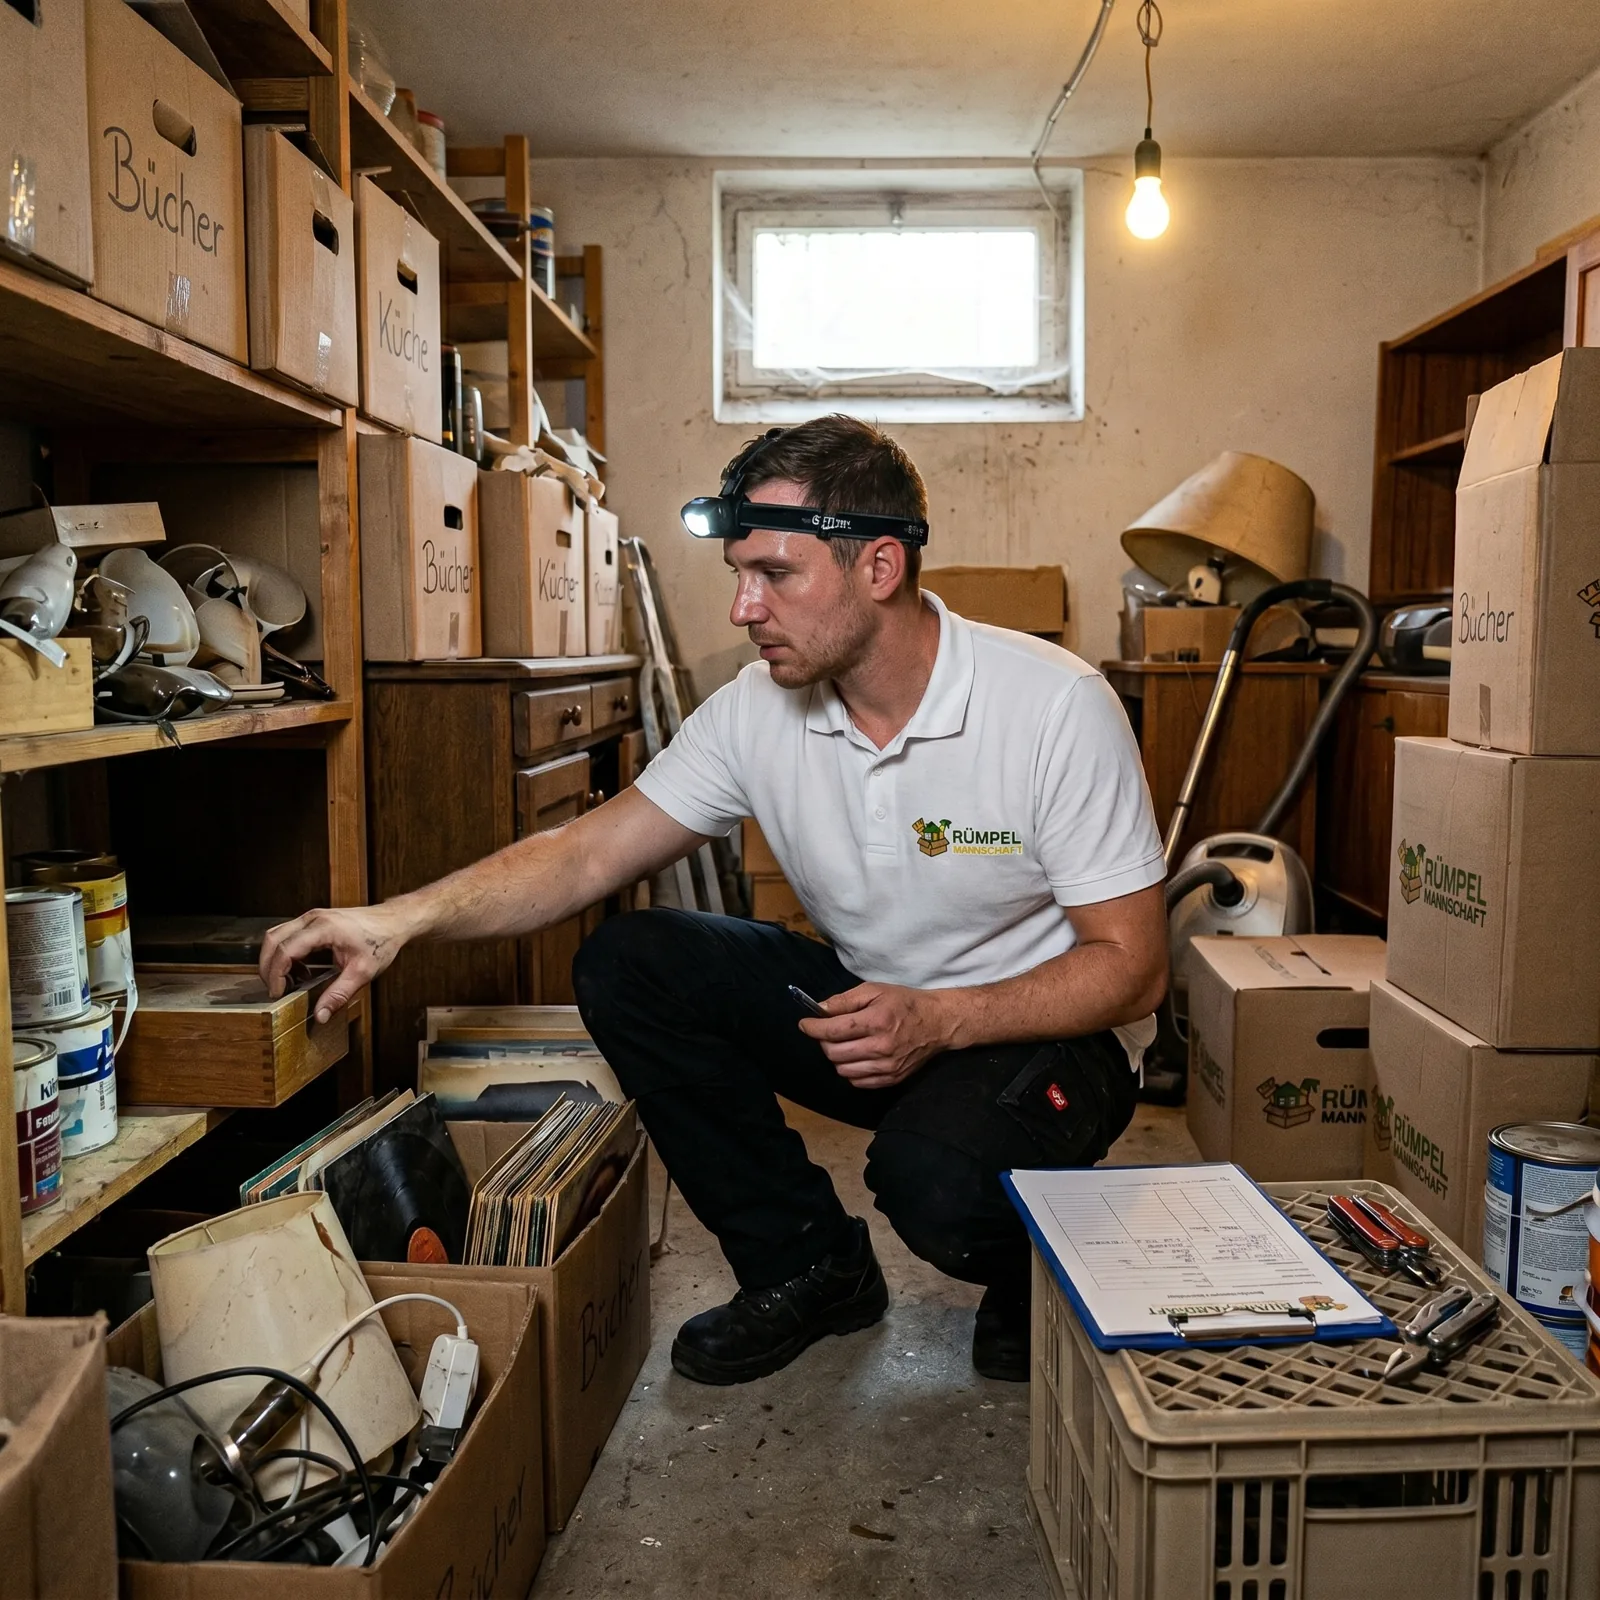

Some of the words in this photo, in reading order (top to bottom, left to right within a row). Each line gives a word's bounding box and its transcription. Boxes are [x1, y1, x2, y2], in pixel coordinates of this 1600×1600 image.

[103, 126, 224, 257] Bücher
[379, 290, 428, 373] Küche
[422, 539, 474, 594] Bücher
[1458, 590, 1515, 644] Bücher
[952, 827, 1022, 845] RÜMPEL
[952, 845, 1023, 855] MANNSCHAFT
[1424, 855, 1487, 907] RÜMPEL
[1424, 888, 1487, 928] MANNSCHAFT
[1393, 1113, 1449, 1182] RÜMPEL
[578, 1248, 643, 1392] Bücher
